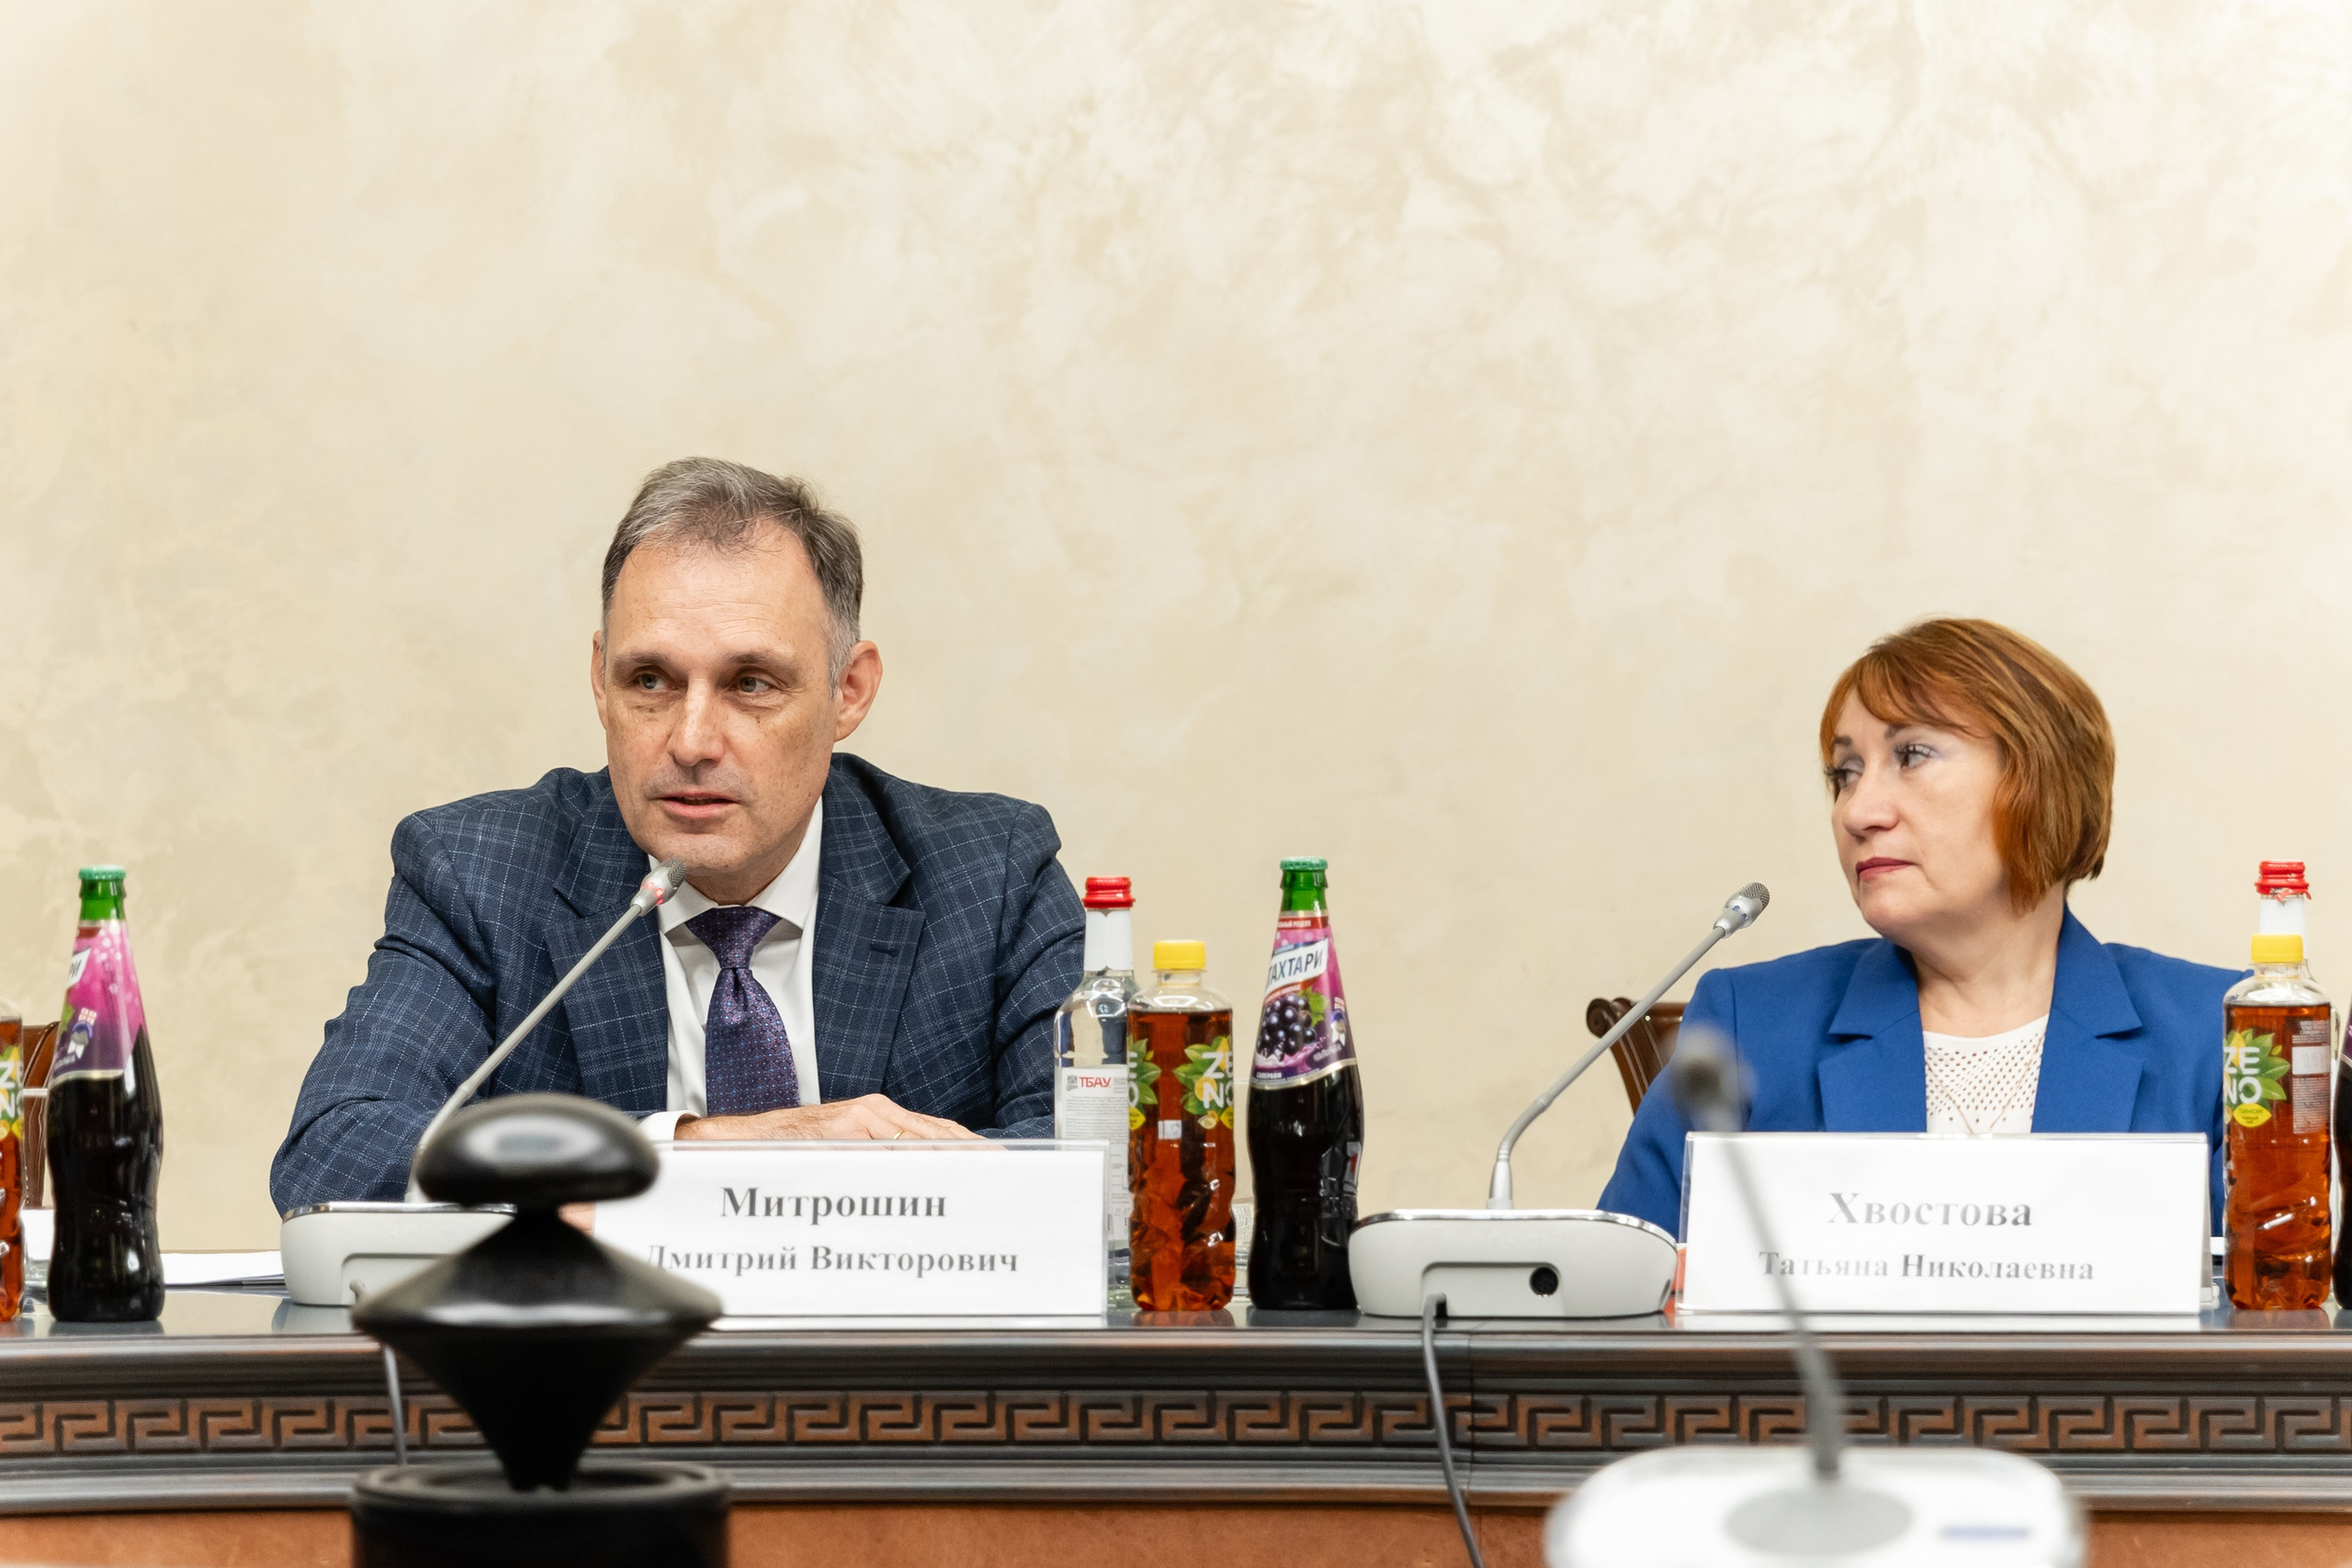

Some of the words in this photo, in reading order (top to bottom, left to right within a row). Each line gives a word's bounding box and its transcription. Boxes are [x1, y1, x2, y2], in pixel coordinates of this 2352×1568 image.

[2222, 1045, 2260, 1075] ZE
[720, 1186, 947, 1226] Митрошин
[1826, 1191, 2033, 1227] Хвостова
[647, 1245, 797, 1278] Дмитрий
[810, 1245, 1019, 1280] Викторович
[1758, 1250, 1889, 1278] Татьяна
[1900, 1253, 2096, 1281] Николаевна
